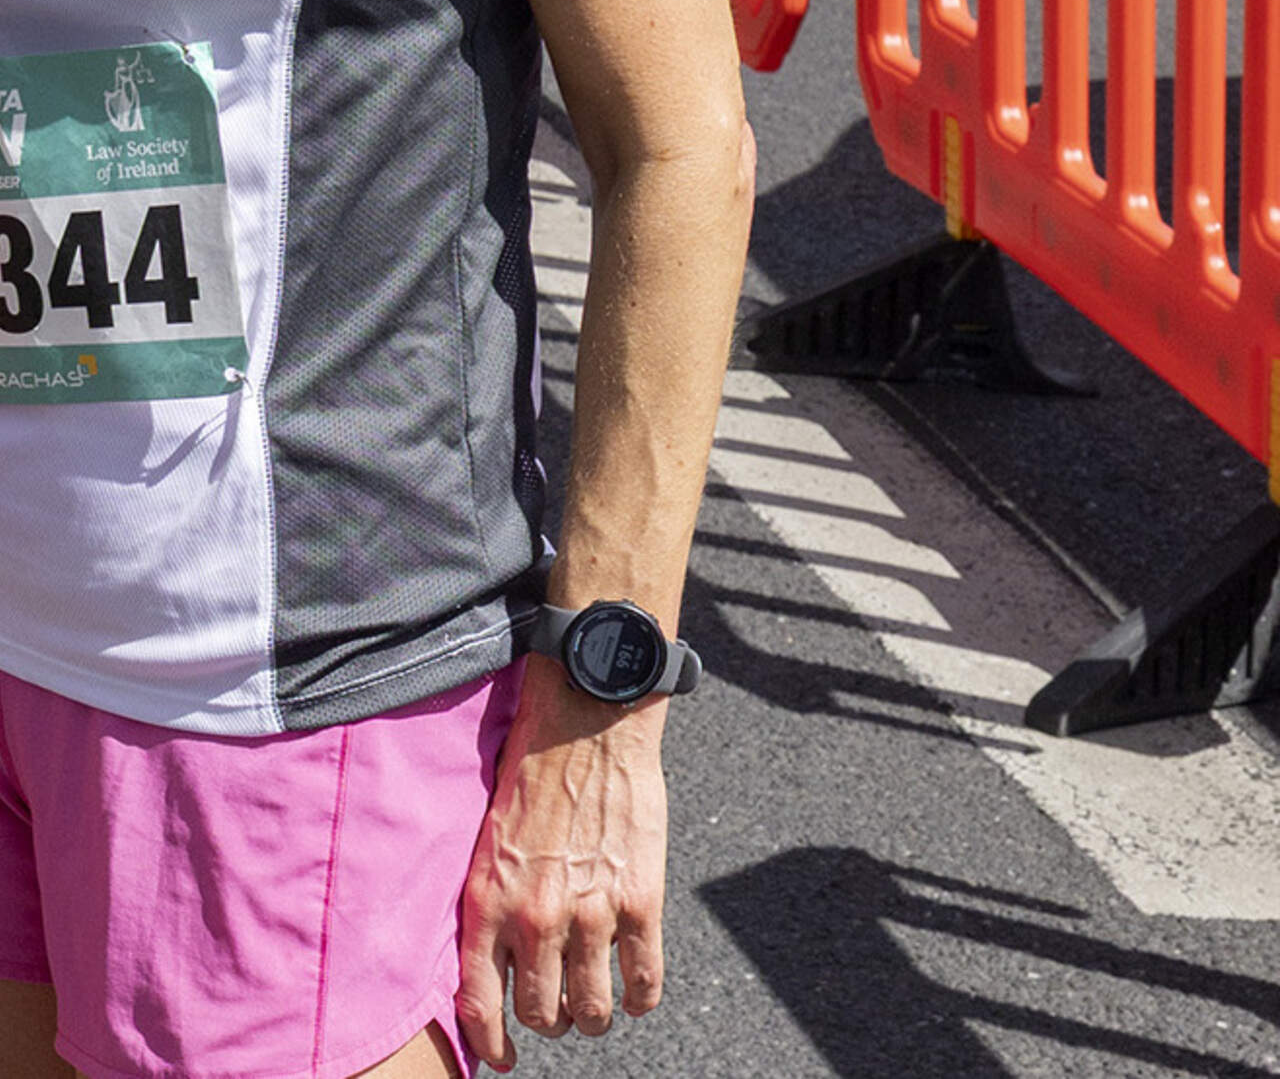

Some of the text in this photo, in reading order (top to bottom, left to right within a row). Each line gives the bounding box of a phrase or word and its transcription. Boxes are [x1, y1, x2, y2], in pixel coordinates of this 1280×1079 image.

[87, 137, 190, 162] Law Society
[96, 159, 180, 185] of Ireland
